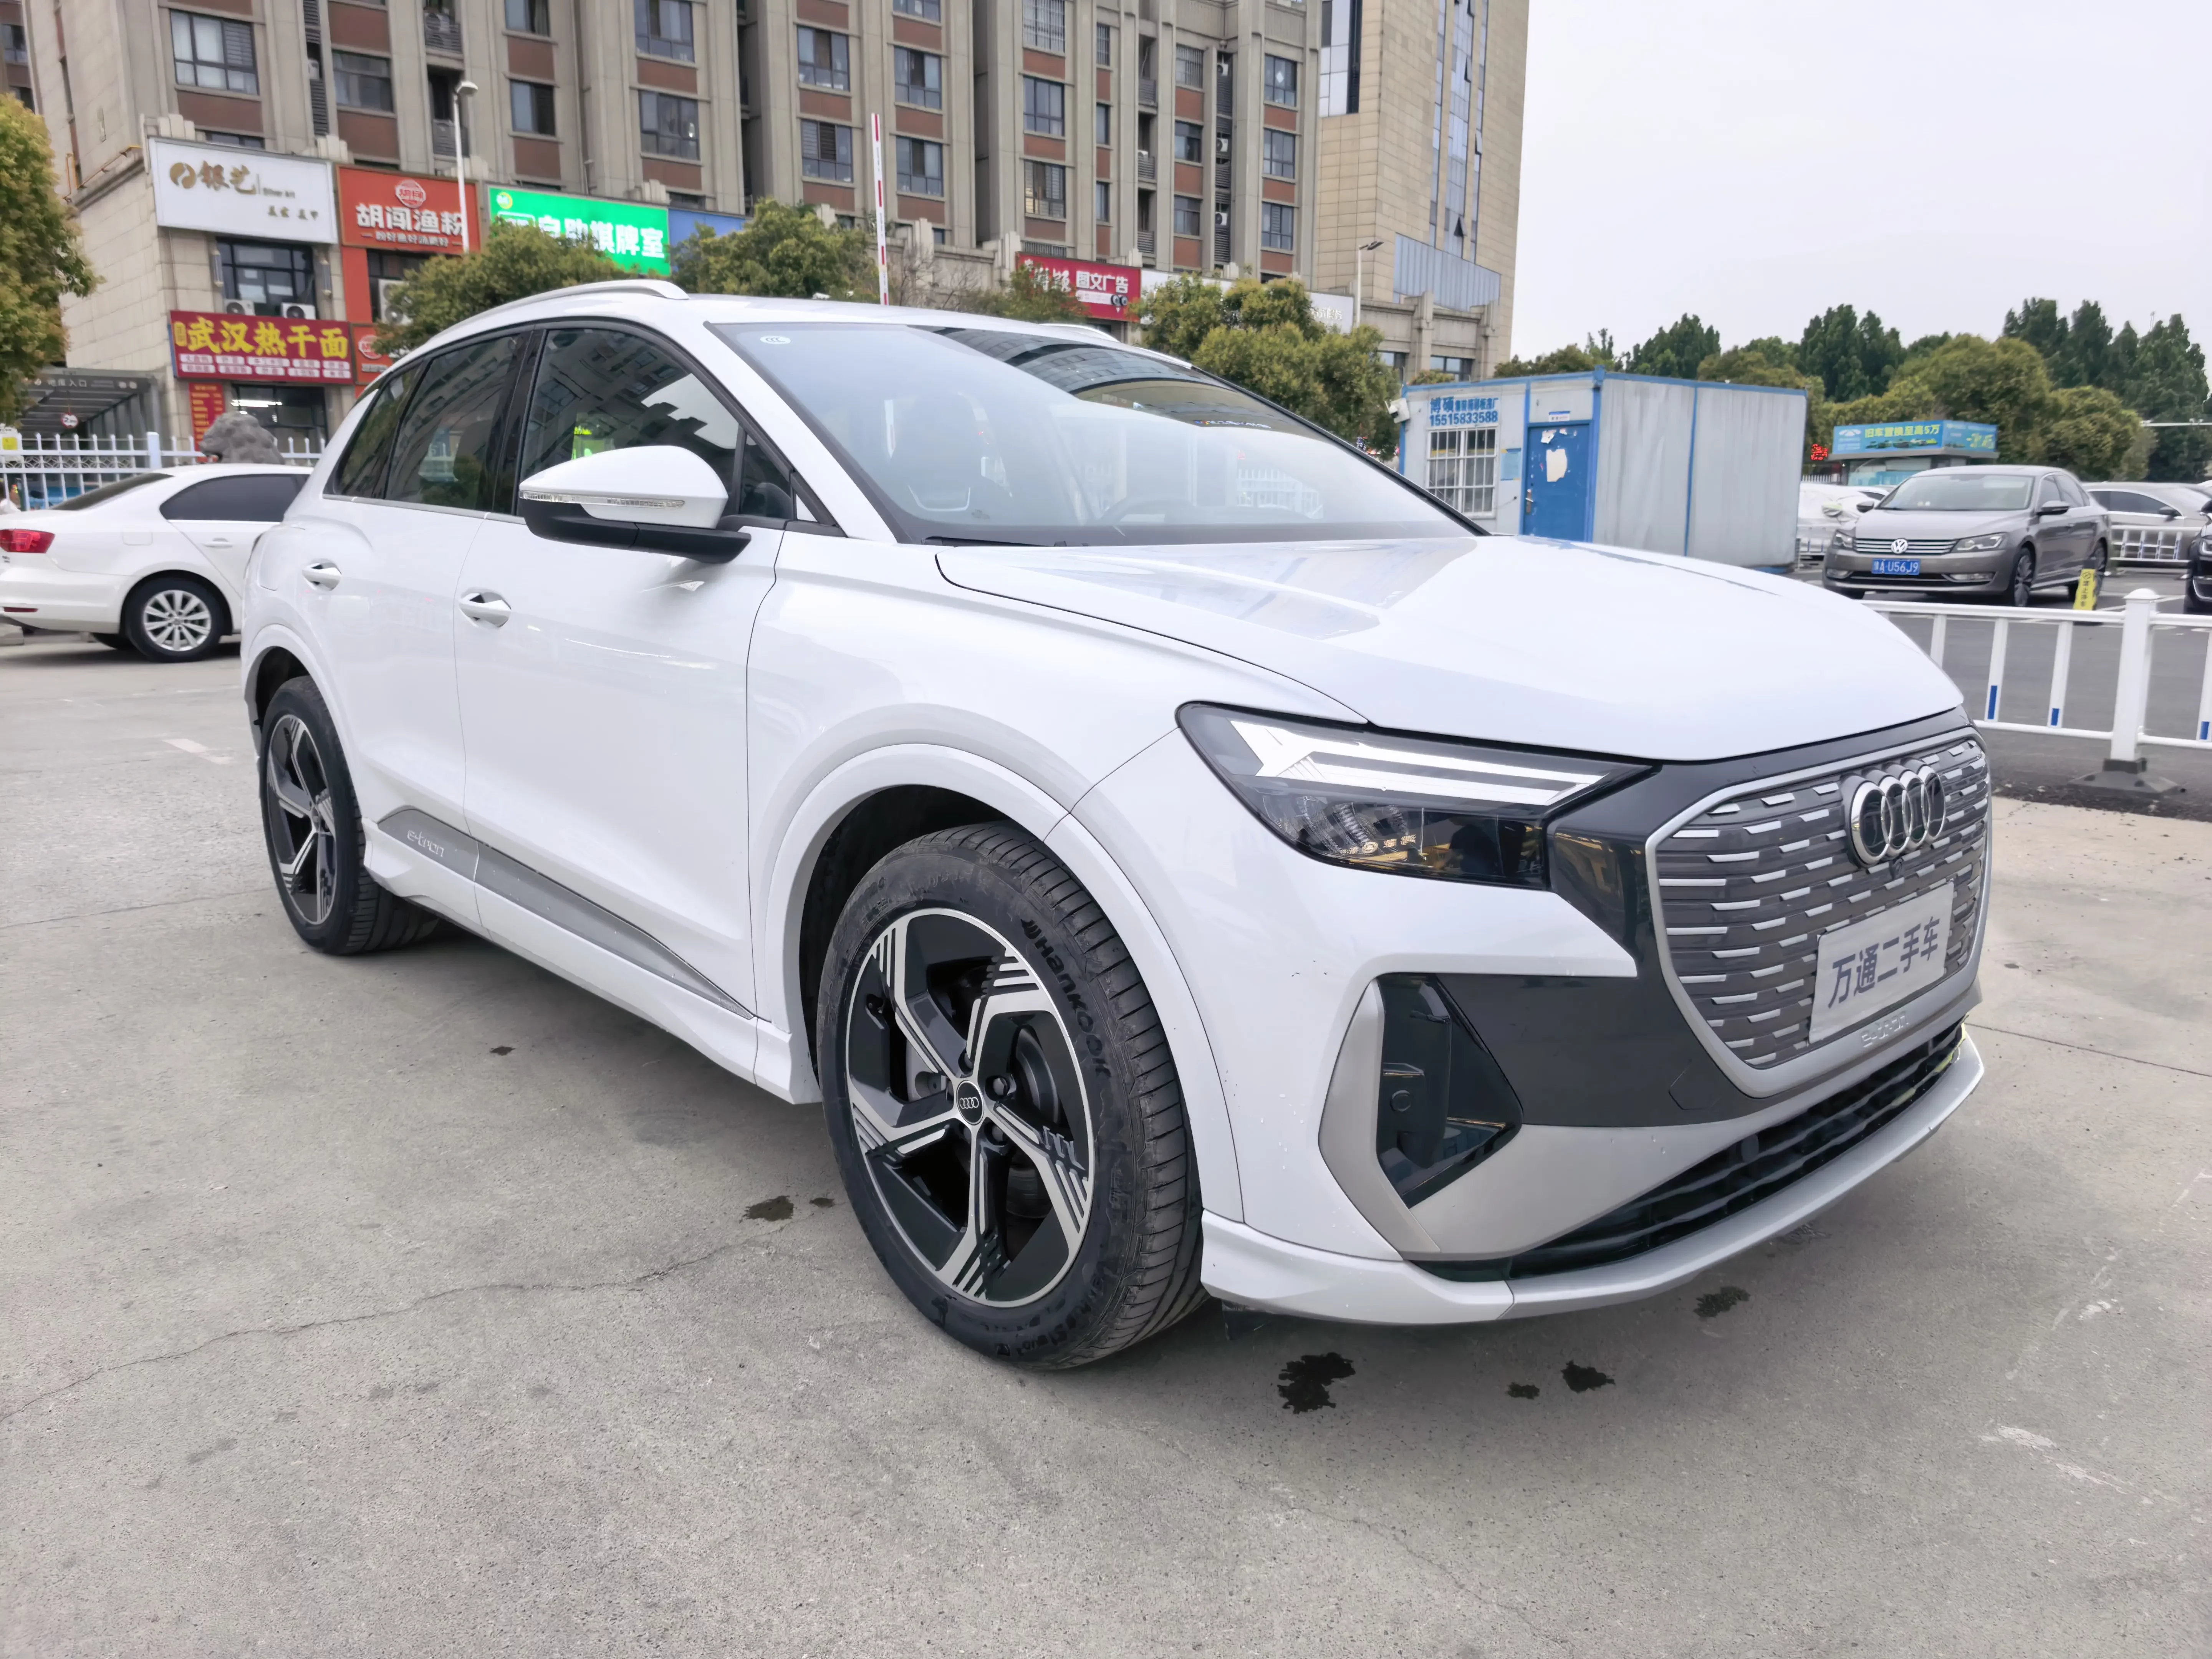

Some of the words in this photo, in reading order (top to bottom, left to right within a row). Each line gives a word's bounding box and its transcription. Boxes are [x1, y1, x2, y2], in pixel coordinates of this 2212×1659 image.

[197, 160, 257, 195] 银艺
[356, 202, 463, 236] 胡闯渔粉
[1076, 270, 1128, 294] 图文广告
[188, 316, 349, 359] 武汉热干面
[1430, 411, 1498, 427] 15515833588
[1828, 916, 1940, 1009] 万通二手车
